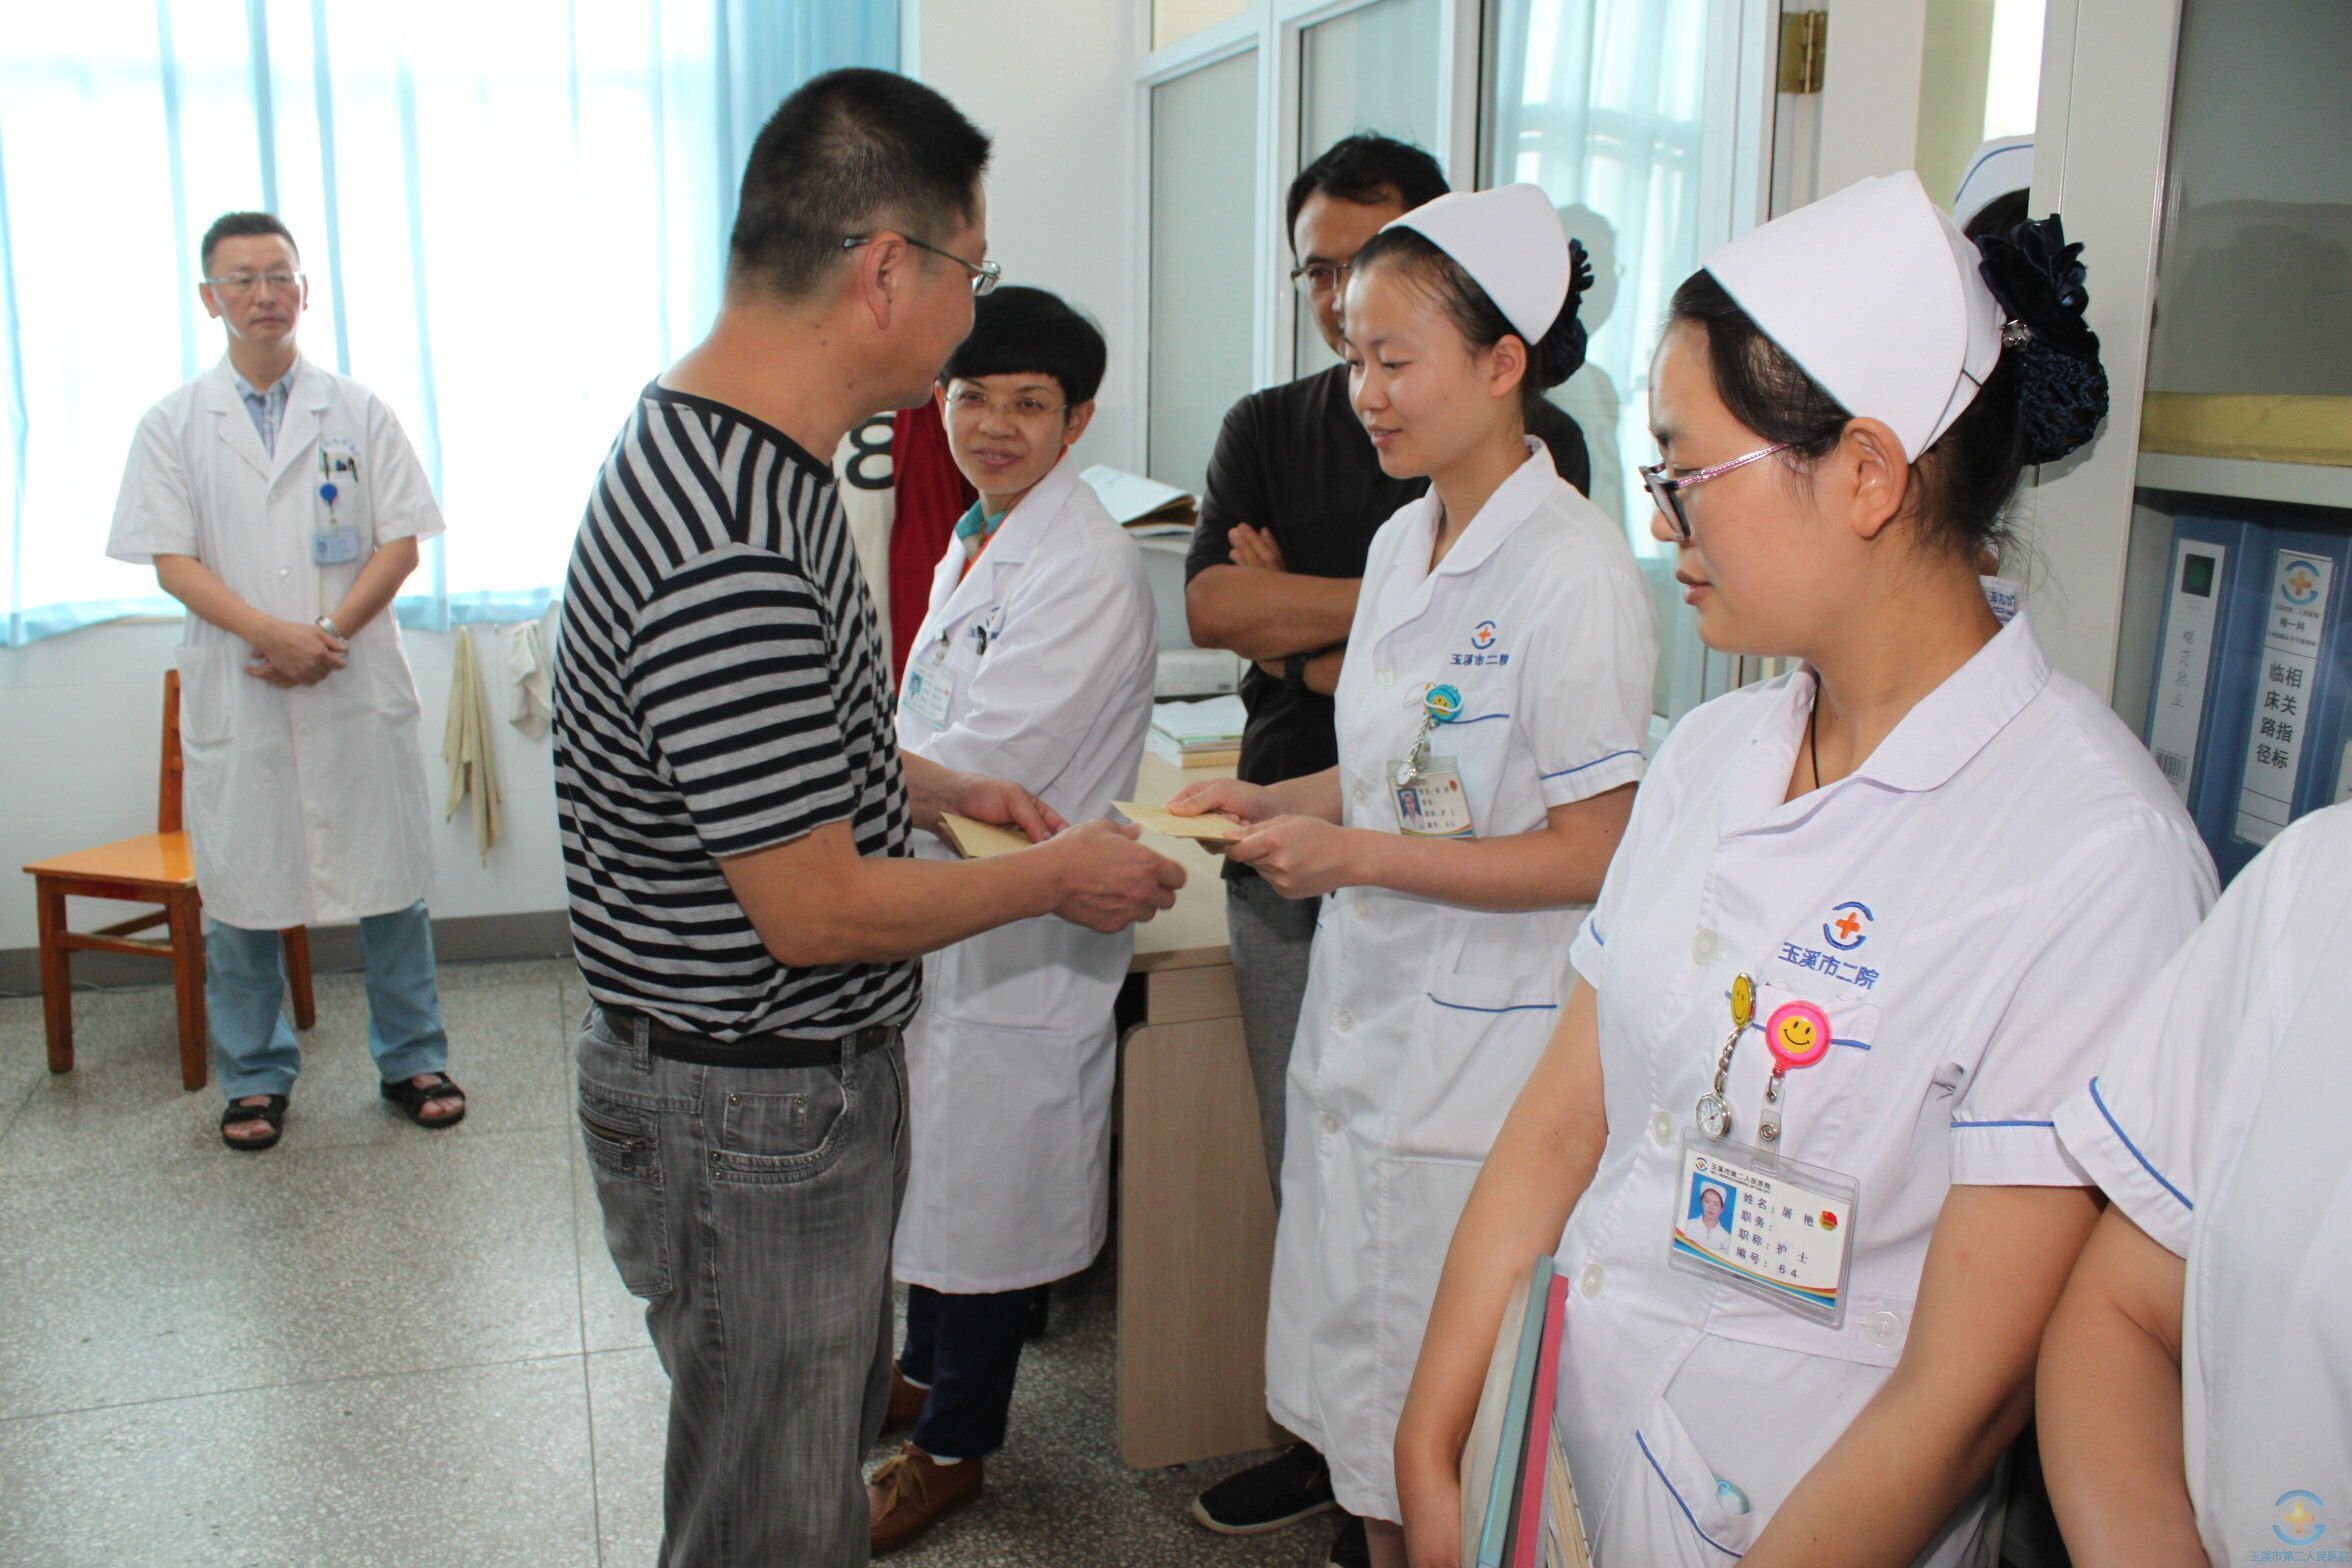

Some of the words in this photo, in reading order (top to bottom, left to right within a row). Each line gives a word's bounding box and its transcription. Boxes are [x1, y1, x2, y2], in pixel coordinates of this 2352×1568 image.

[845, 416, 896, 489] 8
[1778, 942, 1880, 990] 玉溪市二院
